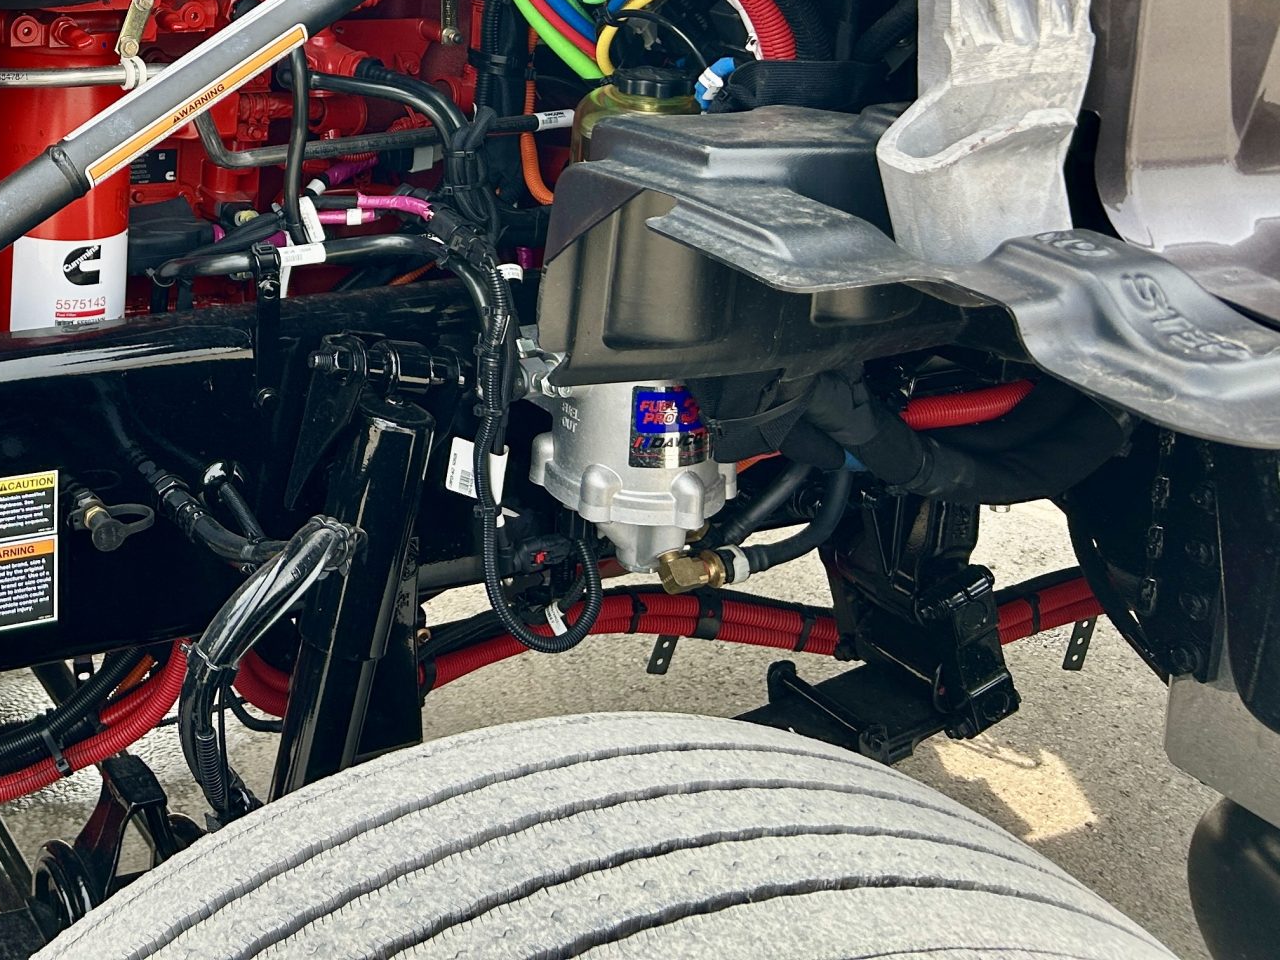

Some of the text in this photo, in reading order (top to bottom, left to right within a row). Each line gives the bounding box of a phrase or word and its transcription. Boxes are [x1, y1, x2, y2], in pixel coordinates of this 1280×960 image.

[179, 84, 224, 118] WARNING
[63, 245, 99, 272] Cummins
[56, 296, 106, 310] 5575143
[640, 400, 677, 413] FUEL
[562, 417, 578, 432] OUT
[643, 412, 677, 425] PRO
[8, 477, 53, 490] CAUTION
